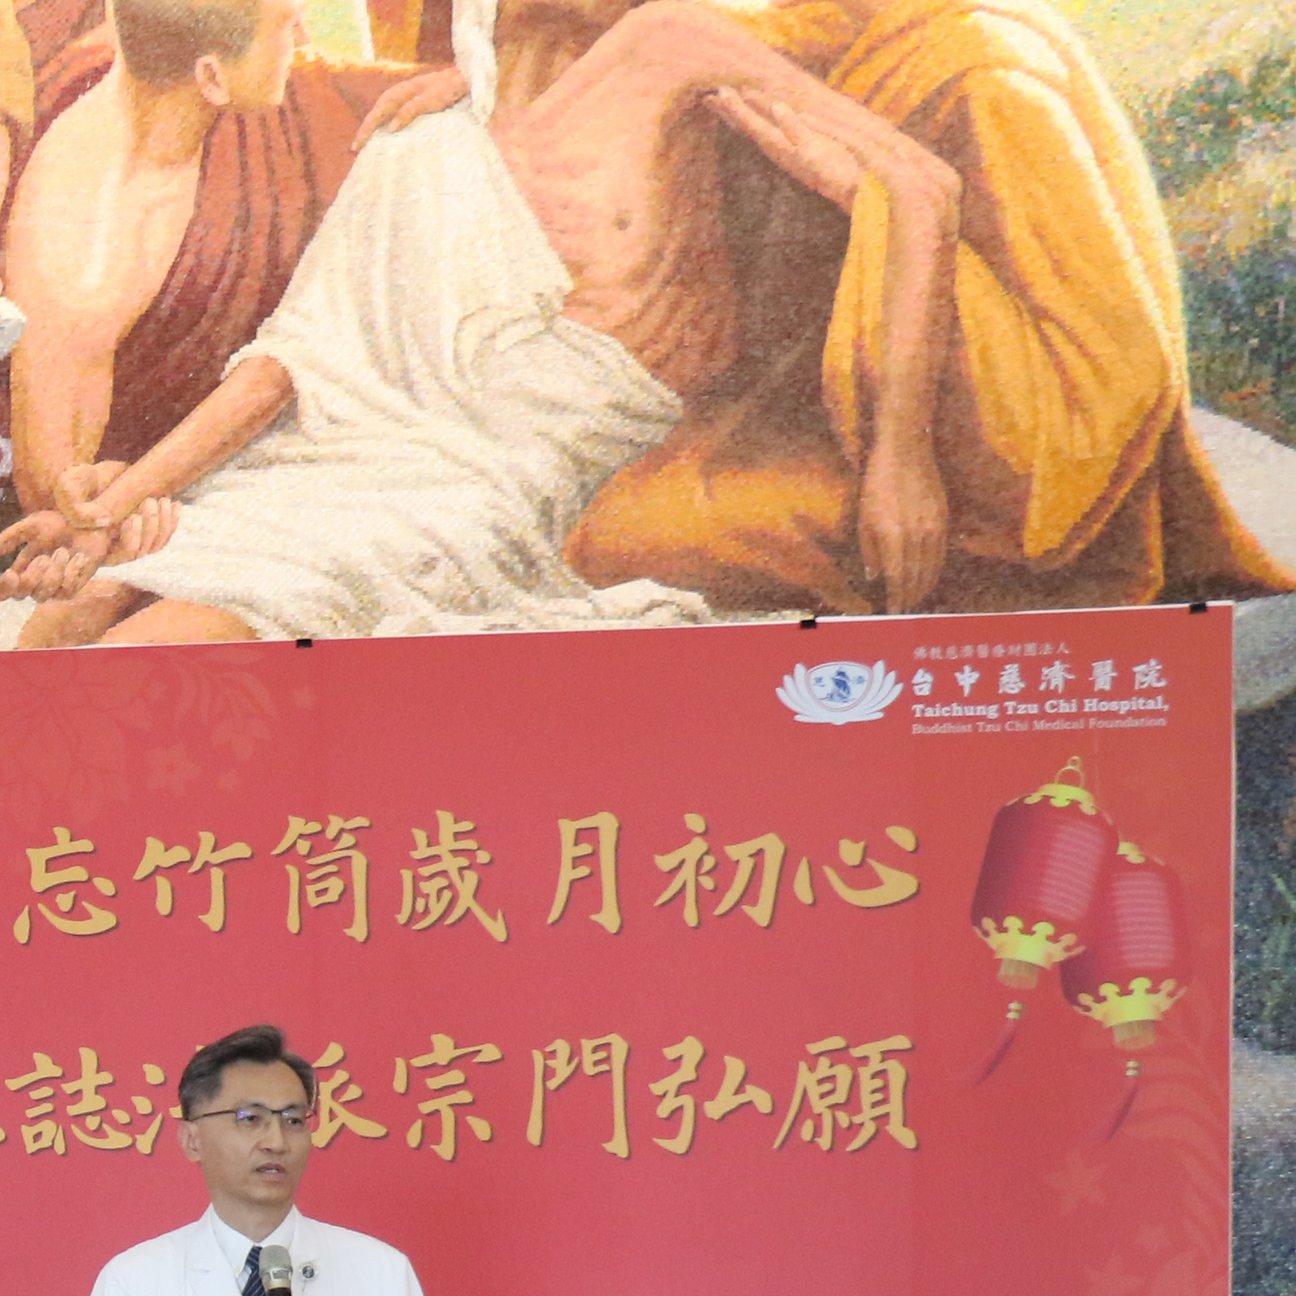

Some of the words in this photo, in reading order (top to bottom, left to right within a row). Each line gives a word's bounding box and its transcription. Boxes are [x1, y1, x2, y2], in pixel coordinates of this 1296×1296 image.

[911, 658, 1169, 697] 台中慈濟醫院
[911, 703, 1000, 719] Taichung
[1004, 701, 1040, 716] Tzu
[1044, 699, 1079, 714] Chi
[1083, 696, 1170, 714] Hospital,
[911, 721, 973, 736] Buddhist
[976, 720, 1001, 734] Tzu
[1004, 719, 1028, 733] Chi
[1032, 717, 1085, 732] Medical
[1088, 715, 1168, 731] Foundation
